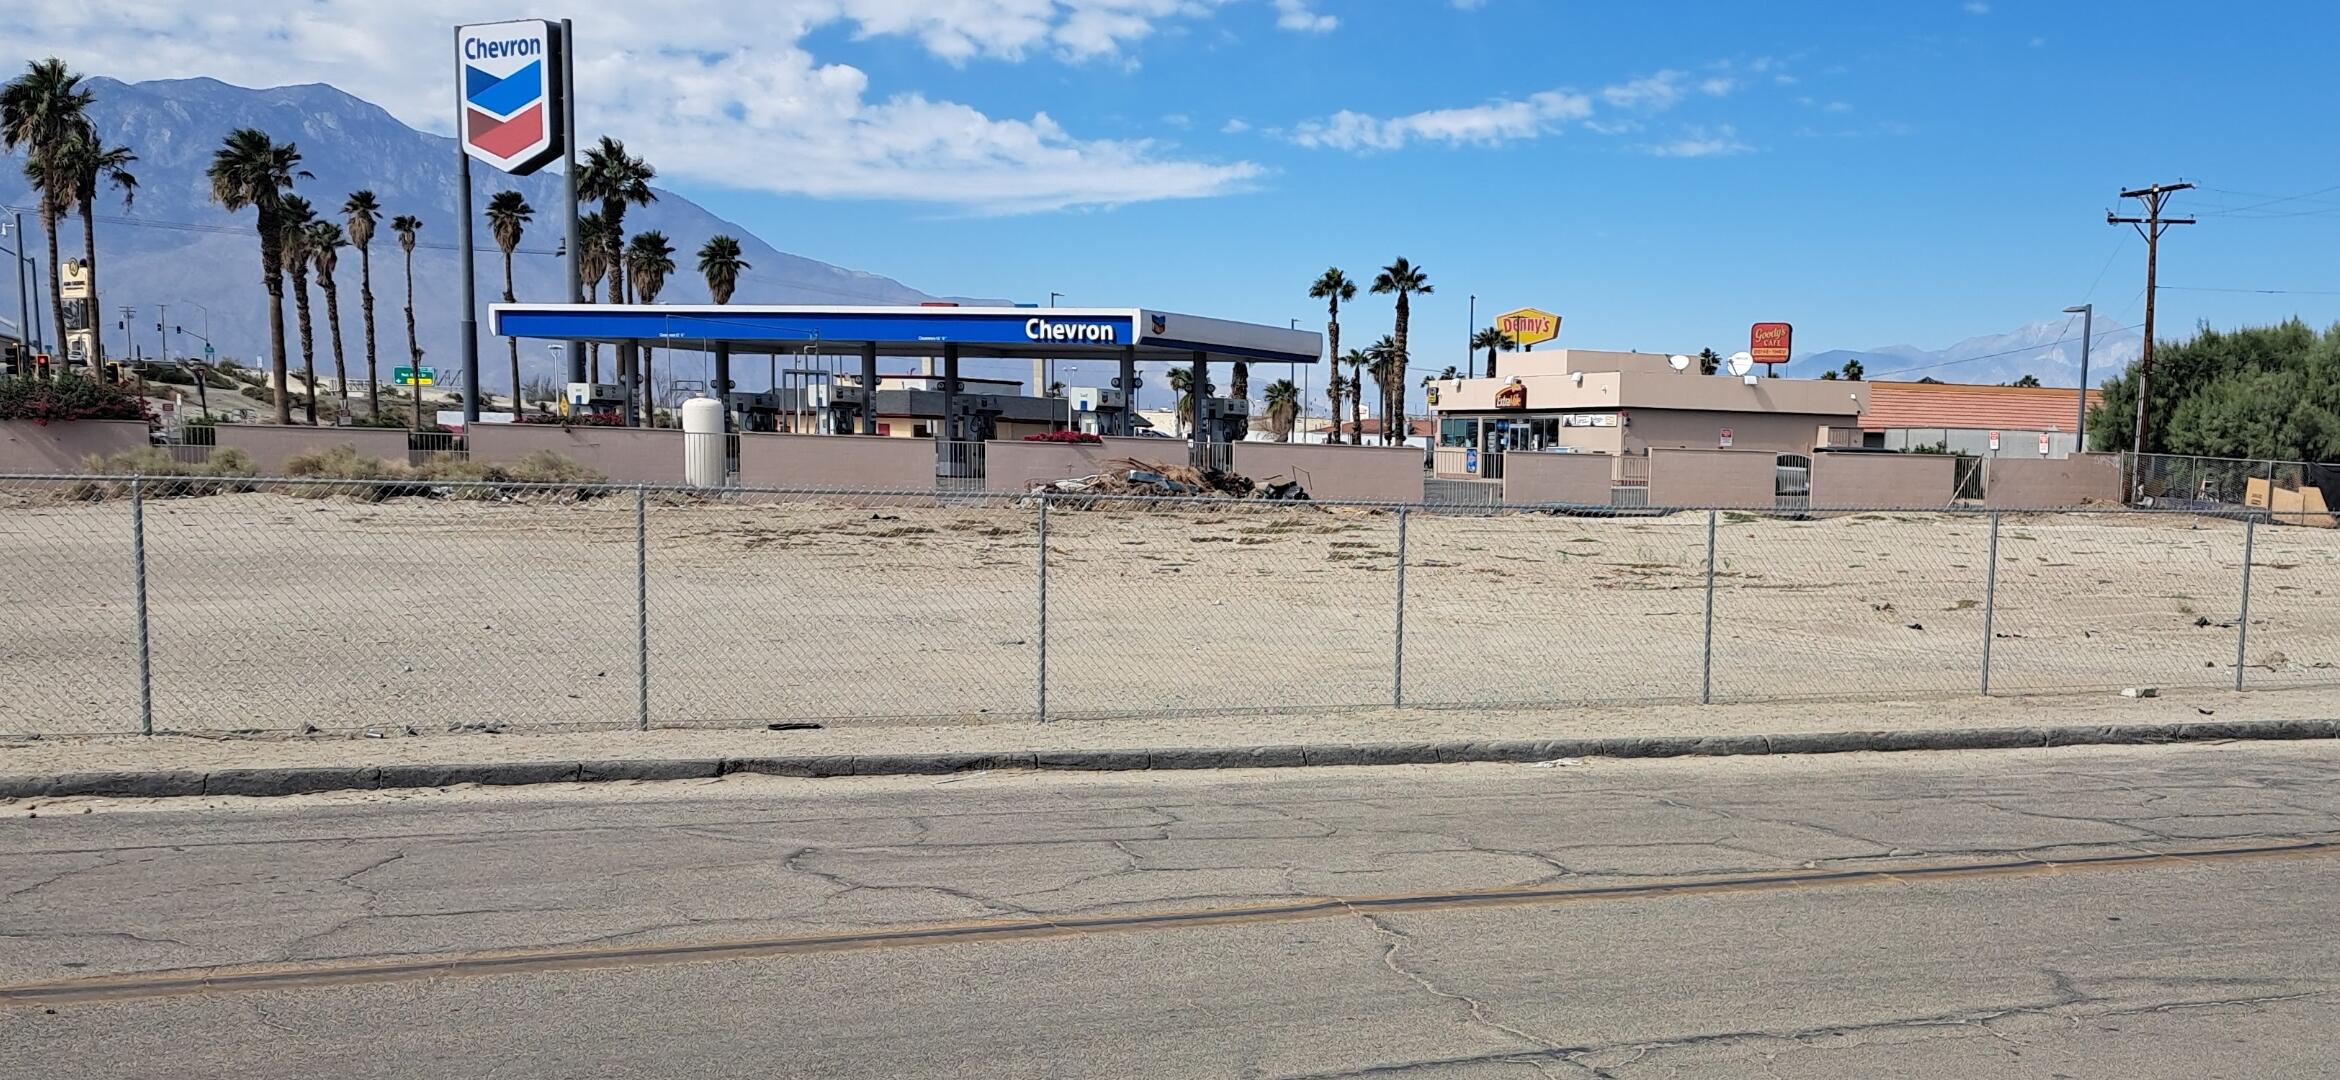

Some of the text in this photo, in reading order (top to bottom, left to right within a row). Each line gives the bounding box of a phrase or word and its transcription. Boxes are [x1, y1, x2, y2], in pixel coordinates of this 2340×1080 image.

[465, 37, 541, 60] Chevron
[1025, 318, 1114, 341] Chevron
[1504, 317, 1550, 334] Denny's
[1755, 326, 1786, 343] Goody's
